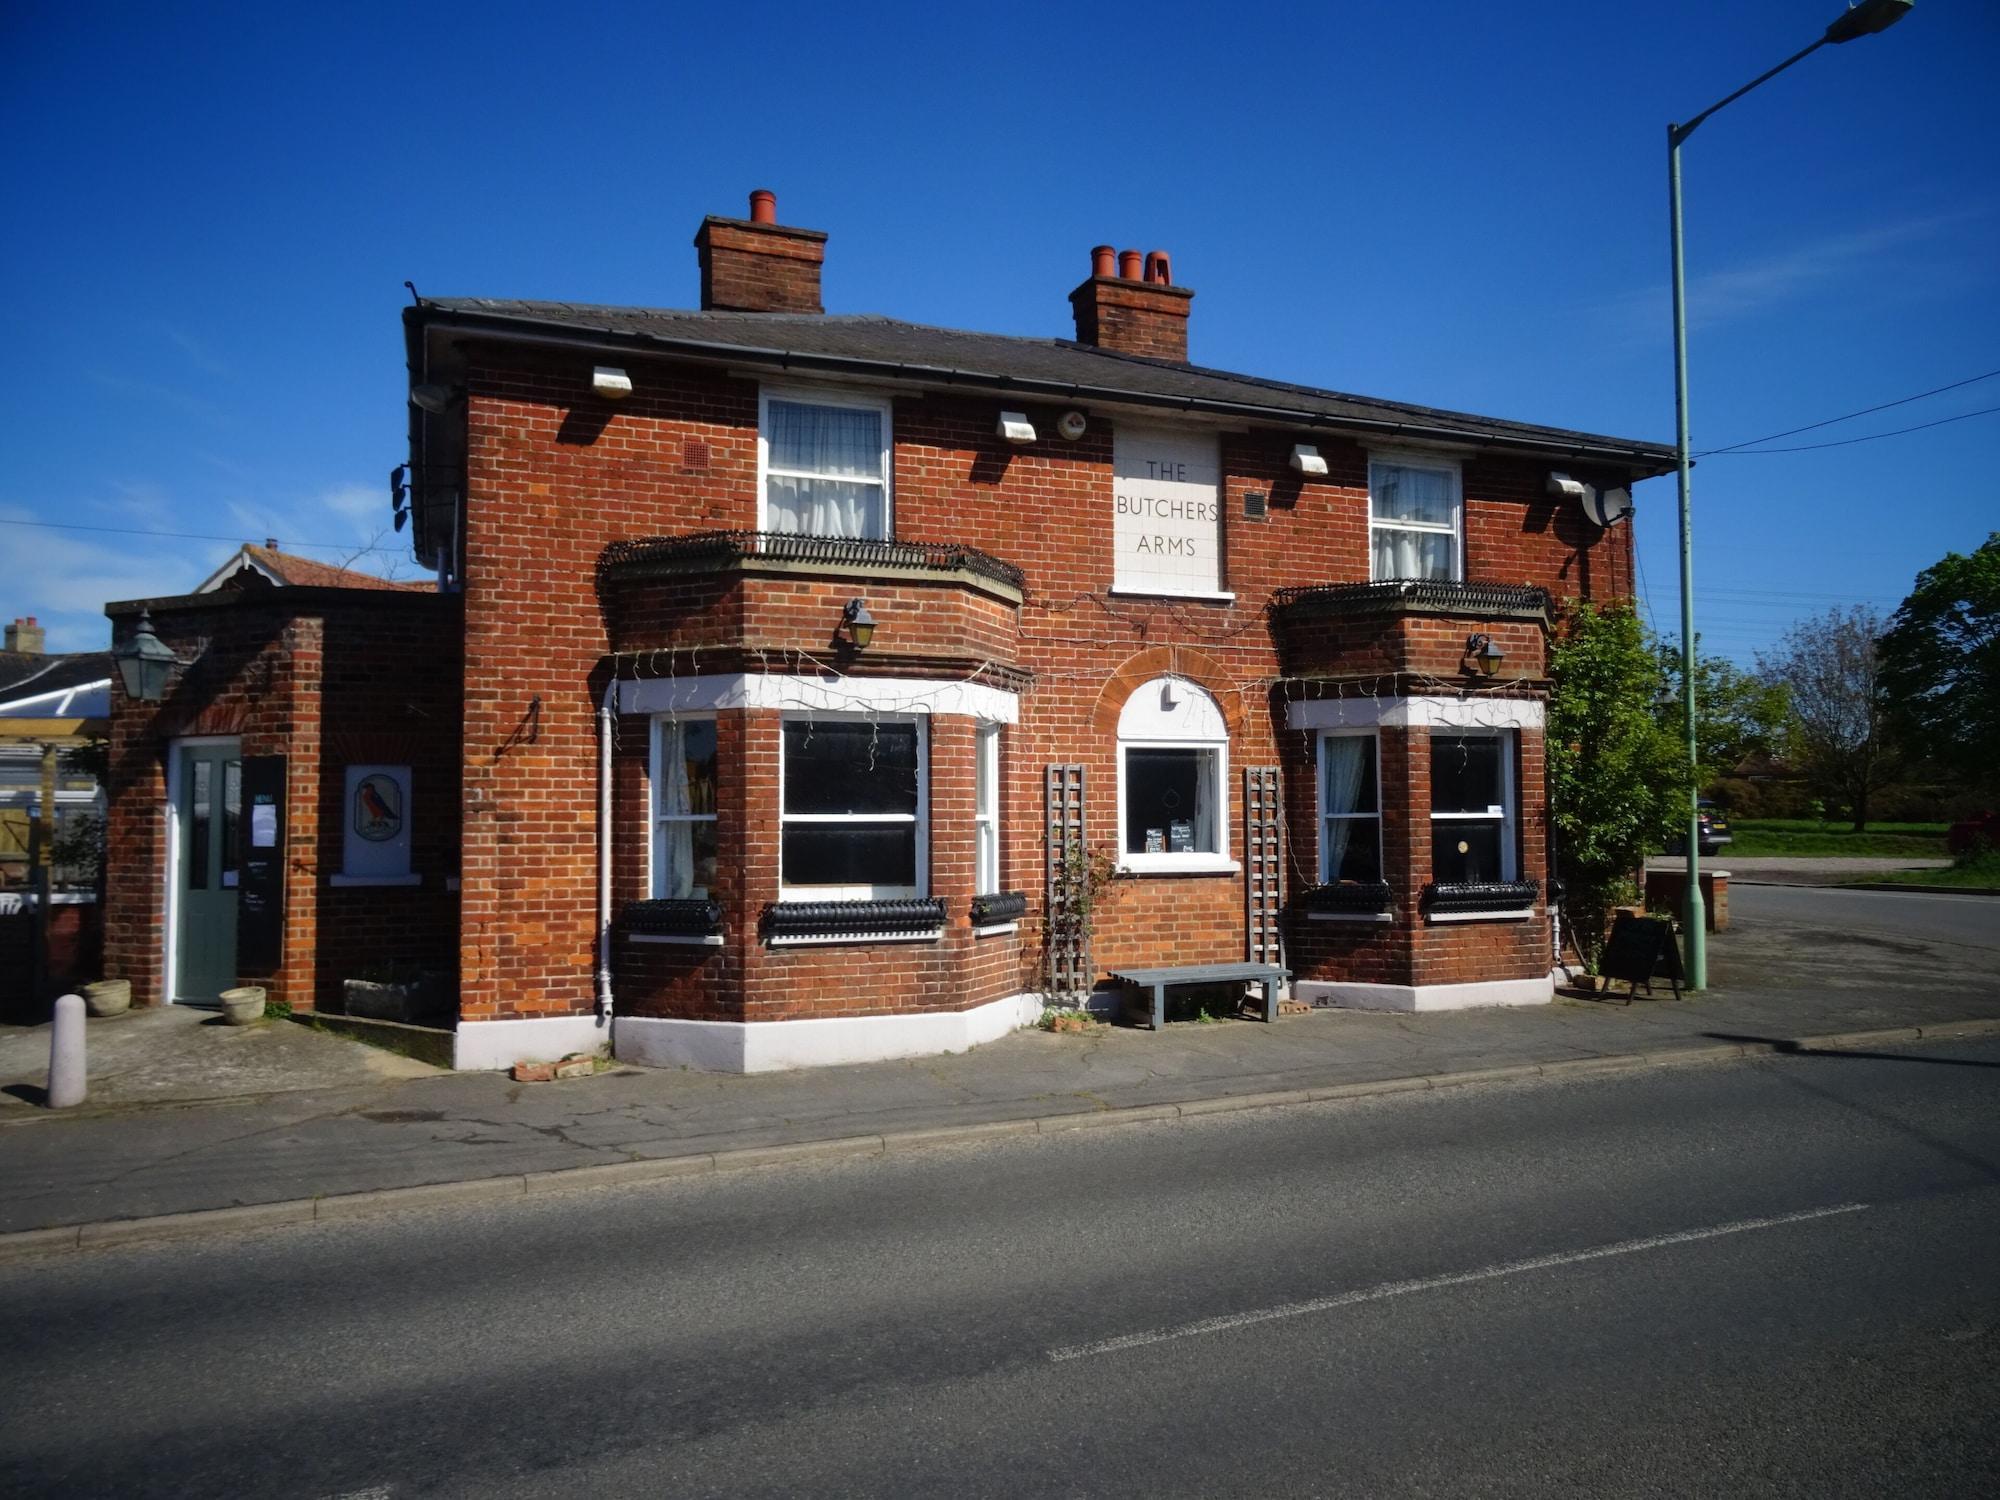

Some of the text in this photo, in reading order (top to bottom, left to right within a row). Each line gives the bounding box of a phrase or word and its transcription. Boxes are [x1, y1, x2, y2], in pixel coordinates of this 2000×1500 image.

[1146, 460, 1186, 482] THE
[1117, 495, 1218, 522] BUTCHERS
[1136, 535, 1196, 557] ARMS
